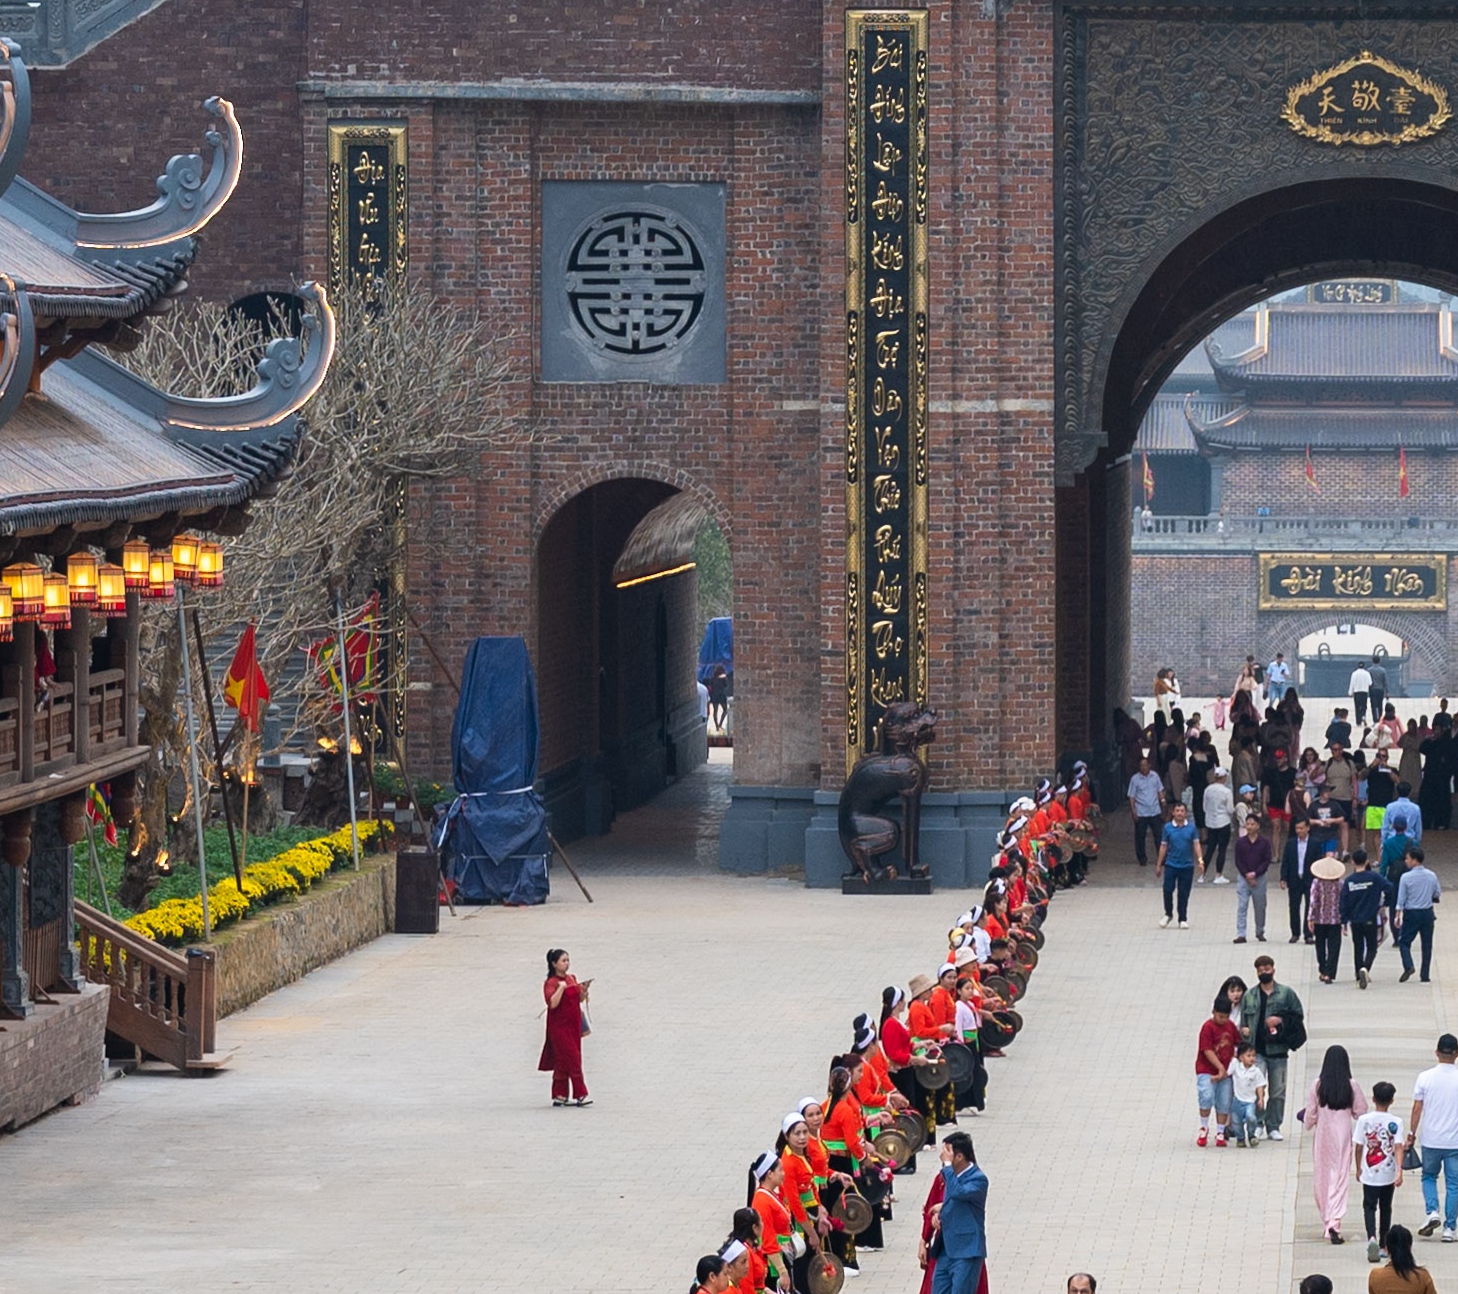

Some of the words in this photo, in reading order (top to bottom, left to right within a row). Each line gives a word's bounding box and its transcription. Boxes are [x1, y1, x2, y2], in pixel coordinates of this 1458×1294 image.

[870, 85, 904, 123] Đính
[1317, 80, 1417, 116] 天敬臺
[354, 151, 384, 185] Địa
[871, 231, 903, 270] Kính
[870, 278, 904, 319] Địa
[875, 426, 899, 469] Vạn
[874, 525, 901, 563] Phú
[872, 570, 902, 613] Quý
[1280, 566, 1323, 595] Đài
[1332, 565, 1374, 596] Kính
[1383, 567, 1425, 596] Nhân
[872, 621, 903, 659] Thọ
